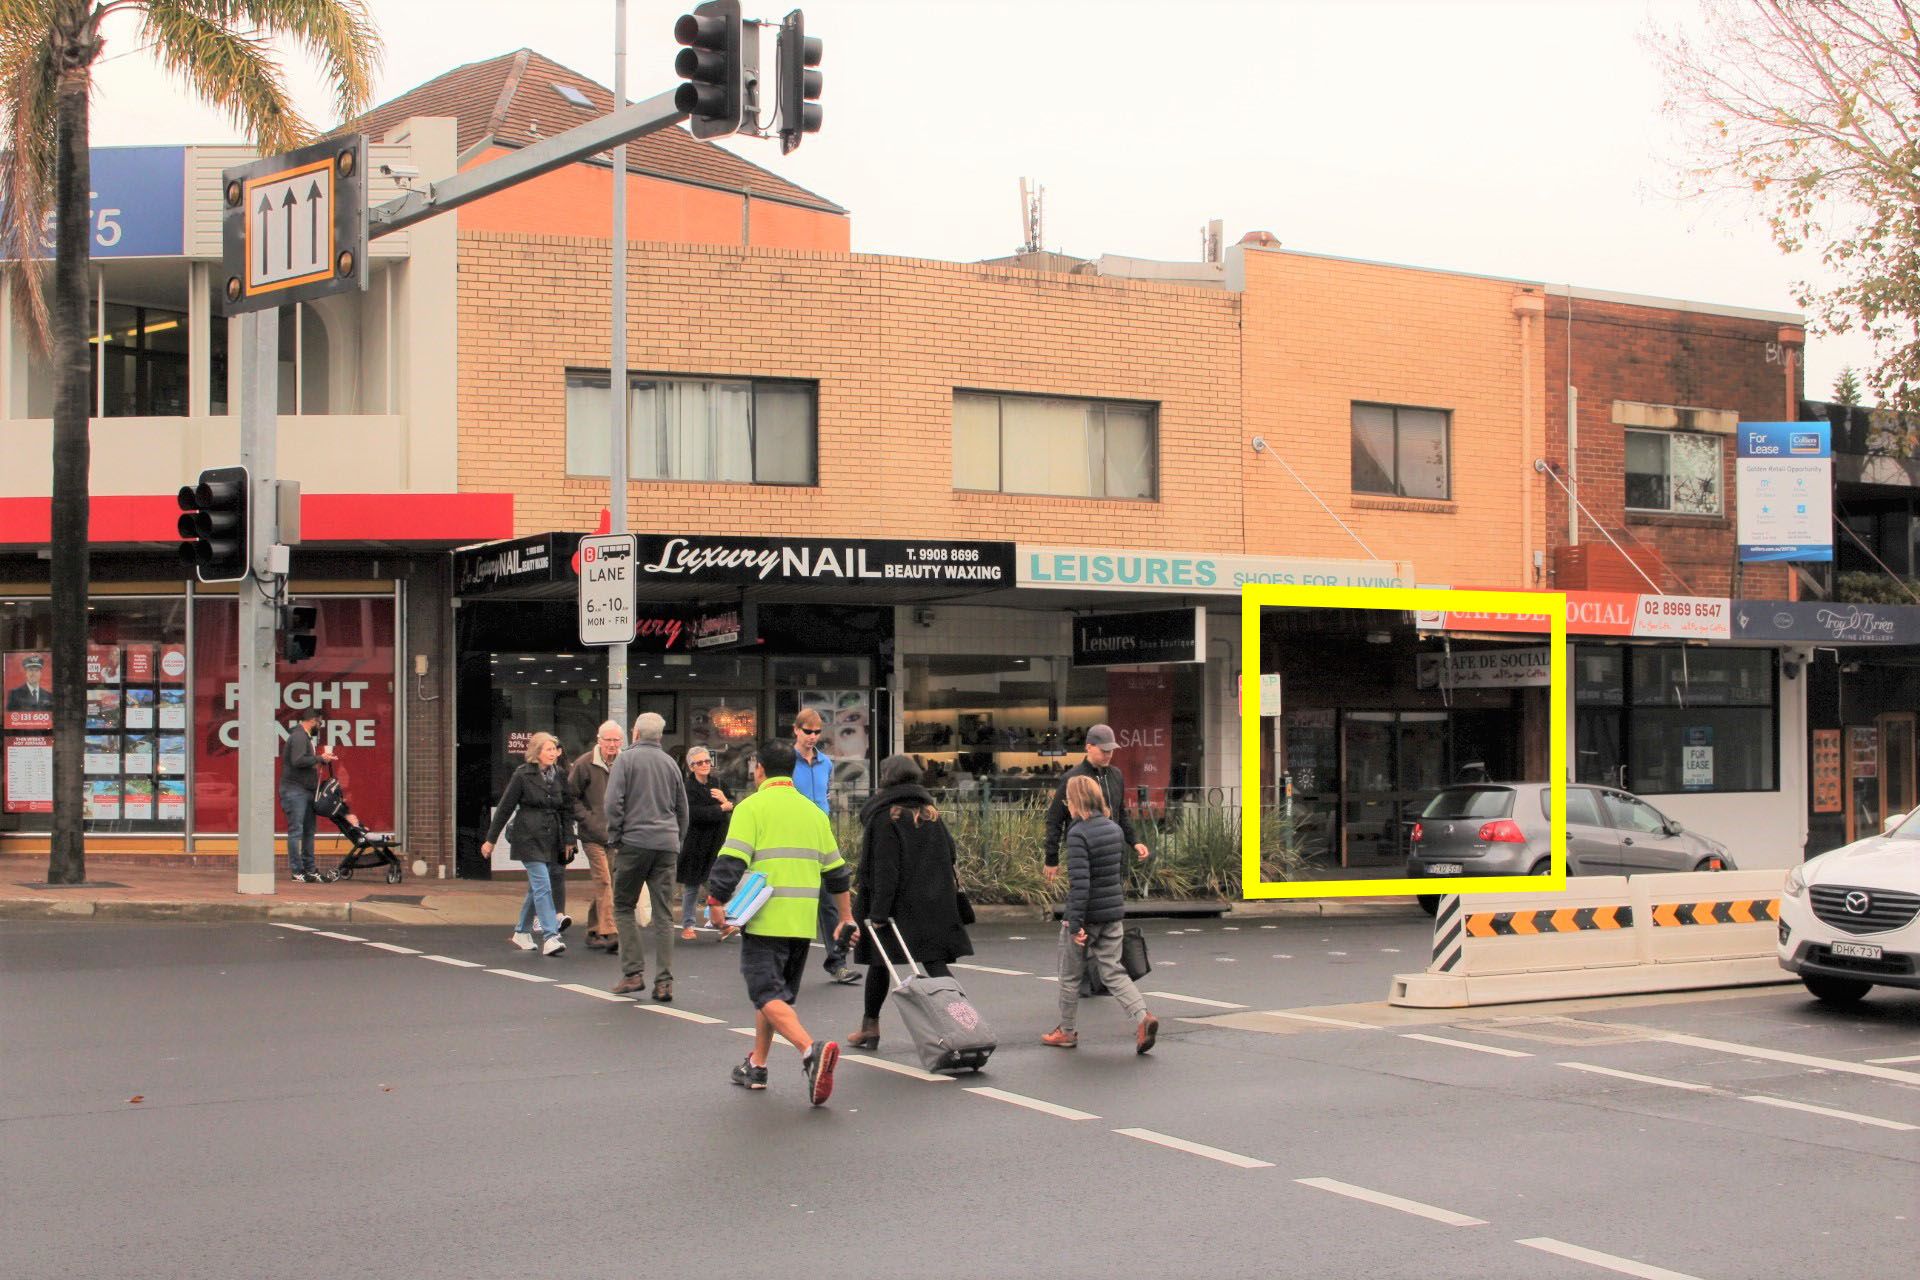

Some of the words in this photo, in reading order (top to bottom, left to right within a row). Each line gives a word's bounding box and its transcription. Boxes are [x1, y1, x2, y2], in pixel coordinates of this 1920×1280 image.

[1749, 432, 1767, 443] For
[1793, 436, 1817, 444] Colliers
[1749, 444, 1779, 454] Lease
[643, 538, 780, 580] Luxury
[782, 546, 882, 578] NAIL
[906, 548, 916, 560] T.
[919, 549, 948, 561] 9908
[951, 549, 979, 562] 8696
[499, 549, 522, 577] NAIL
[589, 567, 625, 582] LANE
[884, 564, 941, 579] BEAUTY
[945, 564, 1002, 580] WAXING
[1030, 554, 1217, 587] LEISURES
[1233, 572, 1295, 588] SHOES
[1303, 575, 1338, 588] FOR
[1566, 601, 1630, 625] OCIAL
[1644, 600, 1659, 615] 02
[1663, 602, 1691, 616] 8969
[1695, 603, 1722, 618] 6547
[588, 617, 605, 626] MON
[615, 616, 628, 625] FRI
[1816, 608, 1848, 639] Troy
[1081, 626, 1136, 652] Leisures
[1480, 655, 1498, 668] DE
[1500, 651, 1550, 667] SOCIAL
[20, 713, 32, 721] 131
[33, 713, 49, 721] 600
[511, 732, 533, 740] SALE
[1120, 728, 1165, 748] SALE
[1690, 750, 1706, 759] FOR
[1686, 760, 1710, 770] LEASE
